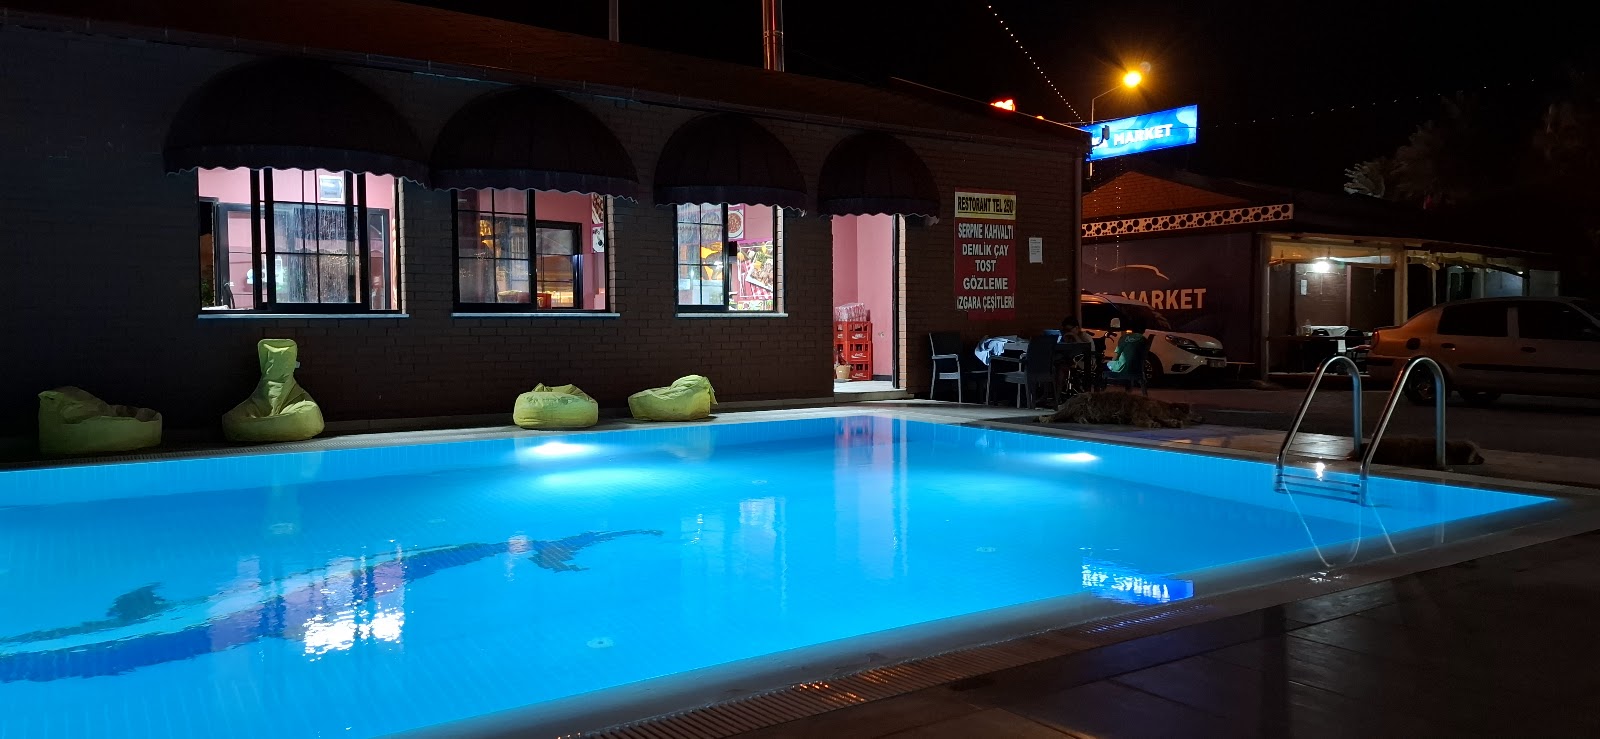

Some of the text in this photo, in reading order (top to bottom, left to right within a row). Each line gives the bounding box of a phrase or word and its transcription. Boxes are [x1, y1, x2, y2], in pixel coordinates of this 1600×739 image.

[1113, 123, 1174, 147] MARKET
[958, 196, 991, 212] RESTORANT
[992, 198, 1002, 213] TEL
[984, 224, 1014, 240] KAHVALTI
[962, 241, 1009, 259] DEMLİK ÇAY
[975, 259, 997, 272] TOST
[963, 274, 1008, 290] GÖZLEME
